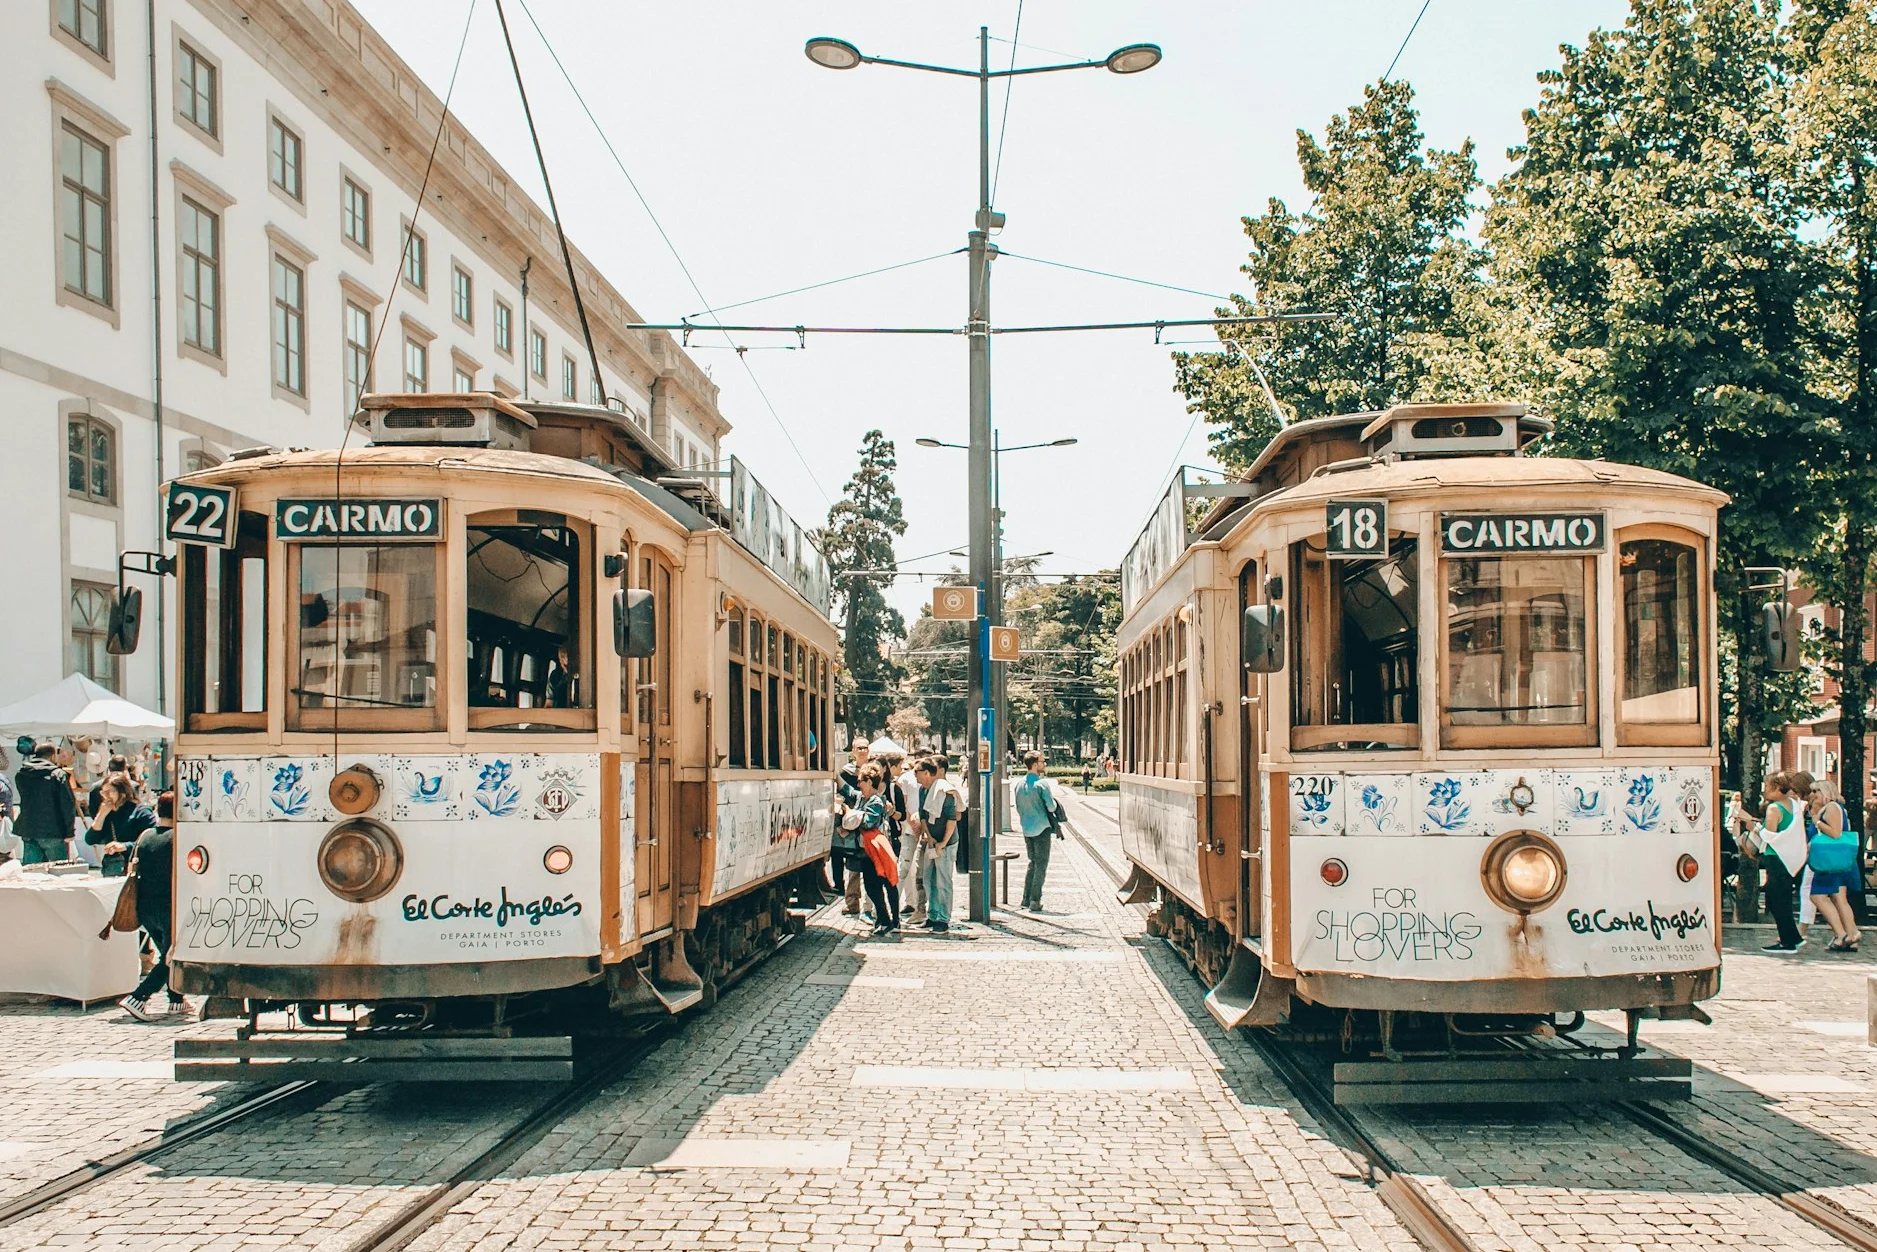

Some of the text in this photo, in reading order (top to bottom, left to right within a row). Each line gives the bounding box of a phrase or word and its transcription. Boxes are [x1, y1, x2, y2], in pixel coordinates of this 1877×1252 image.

[170, 491, 225, 538] 22
[283, 503, 433, 533] CARMO
[1329, 507, 1379, 549] 18
[1448, 517, 1597, 549] CARMO
[180, 760, 204, 782] 218
[1294, 776, 1334, 796] 220
[228, 874, 263, 894] FOR
[1372, 887, 1417, 909] FOR
[186, 896, 319, 928] SHOPPING
[401, 885, 583, 928] El Corte Inglés
[188, 918, 302, 949] LOVERS
[440, 929, 563, 941] DEPARTMENT STORES
[1315, 909, 1482, 941] SHOPPING
[1566, 908, 1595, 935] El
[1592, 908, 1649, 933] Corte
[459, 938, 546, 949] GAIA PORTO
[1335, 931, 1474, 962] LOVERS
[1611, 943, 1705, 954] DEPARTMENT STORES
[1630, 952, 1695, 962] GAIA PORTO
